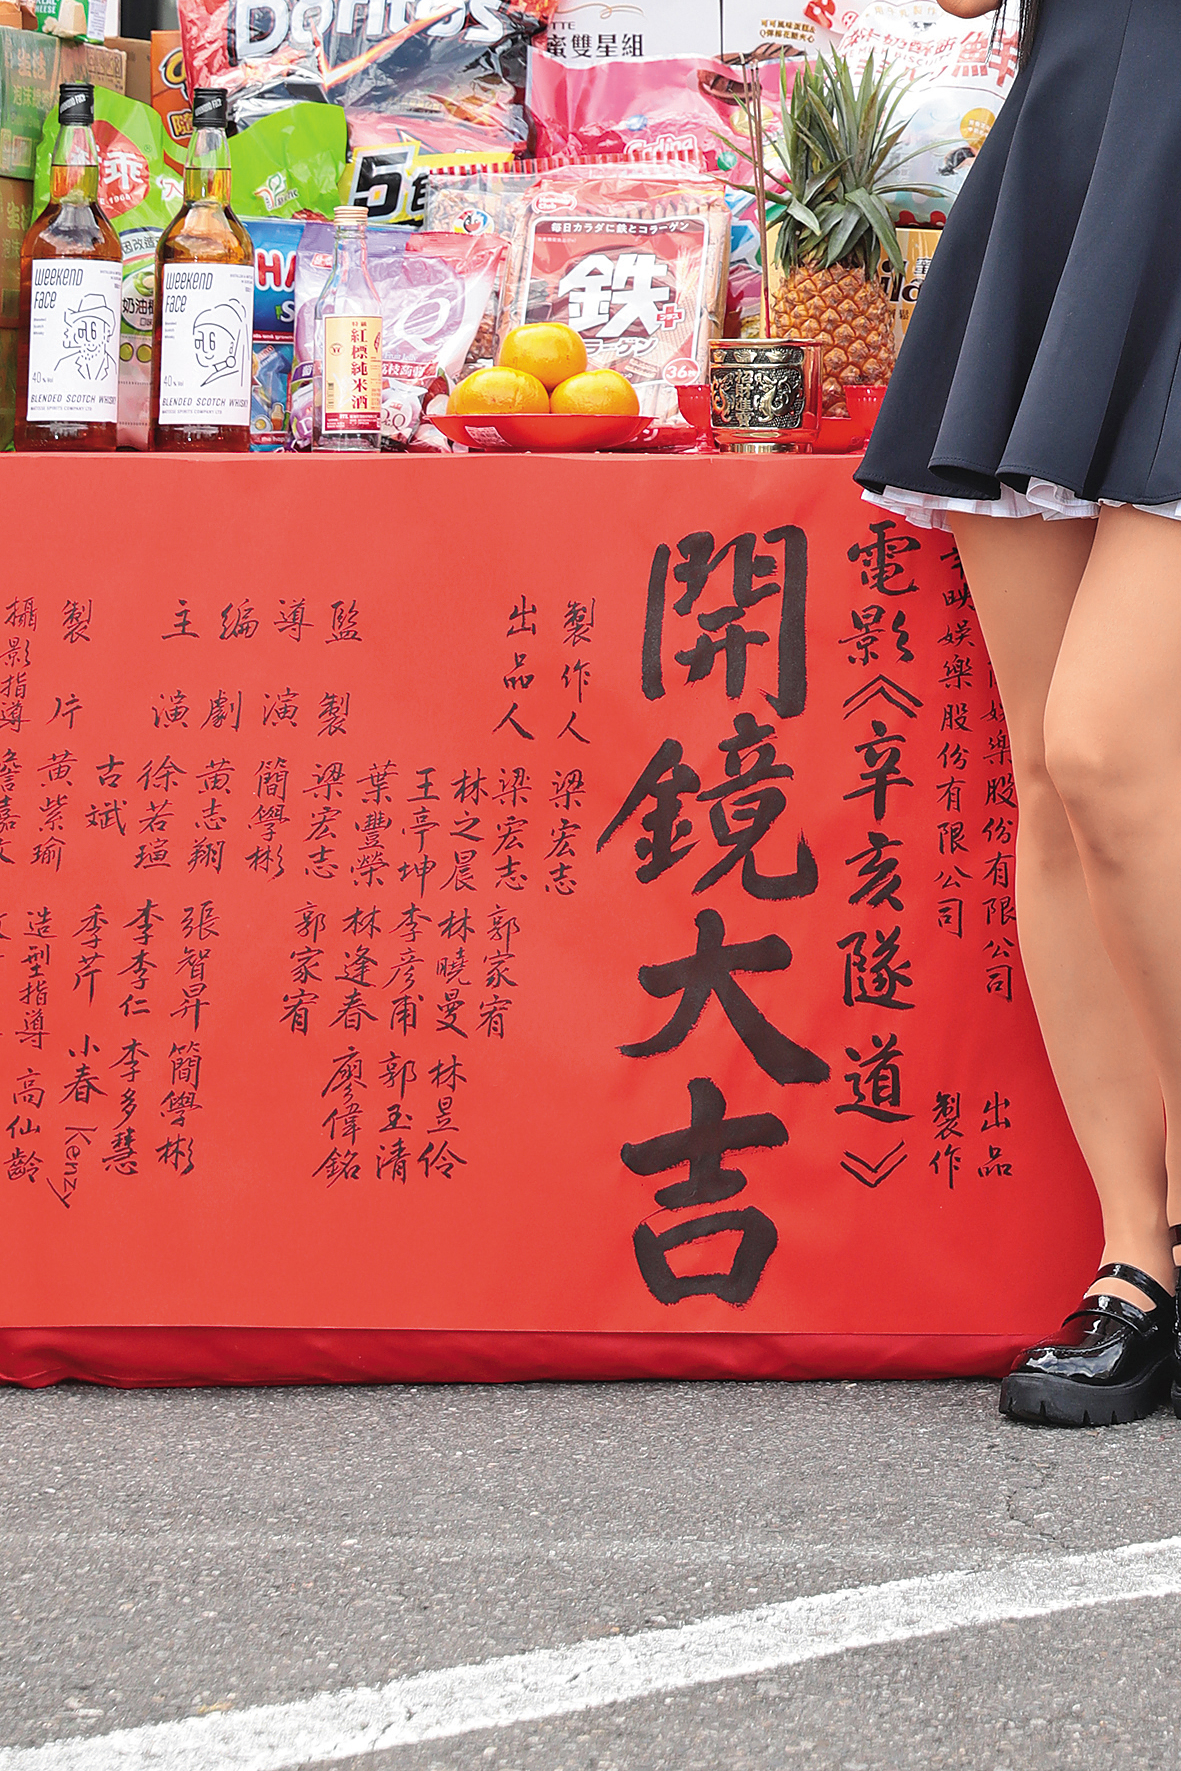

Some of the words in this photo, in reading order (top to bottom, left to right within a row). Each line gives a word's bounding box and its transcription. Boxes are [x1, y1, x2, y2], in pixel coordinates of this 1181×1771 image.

[36, 5, 57, 14] HEESE
[552, 21, 575, 31] TTE
[558, 253, 671, 338] 鉄
[350, 328, 368, 410] 紅標純米酒
[583, 337, 659, 357] ラーゲン
[31, 394, 62, 404] BLENDED
[66, 394, 96, 404] SCOTCH
[162, 397, 193, 407] BLENDED
[196, 397, 226, 407] SCOTCH
[152, 600, 200, 729] 主演
[263, 597, 314, 729] 導演
[493, 596, 538, 741] 出品人
[559, 599, 597, 745] 製作人
[981, 662, 1018, 1003] 娛樂股份有限公司
[597, 525, 831, 1309] 開鏡大吉
[929, 1092, 966, 1190] 製作
[977, 1091, 1014, 1180] 出品
